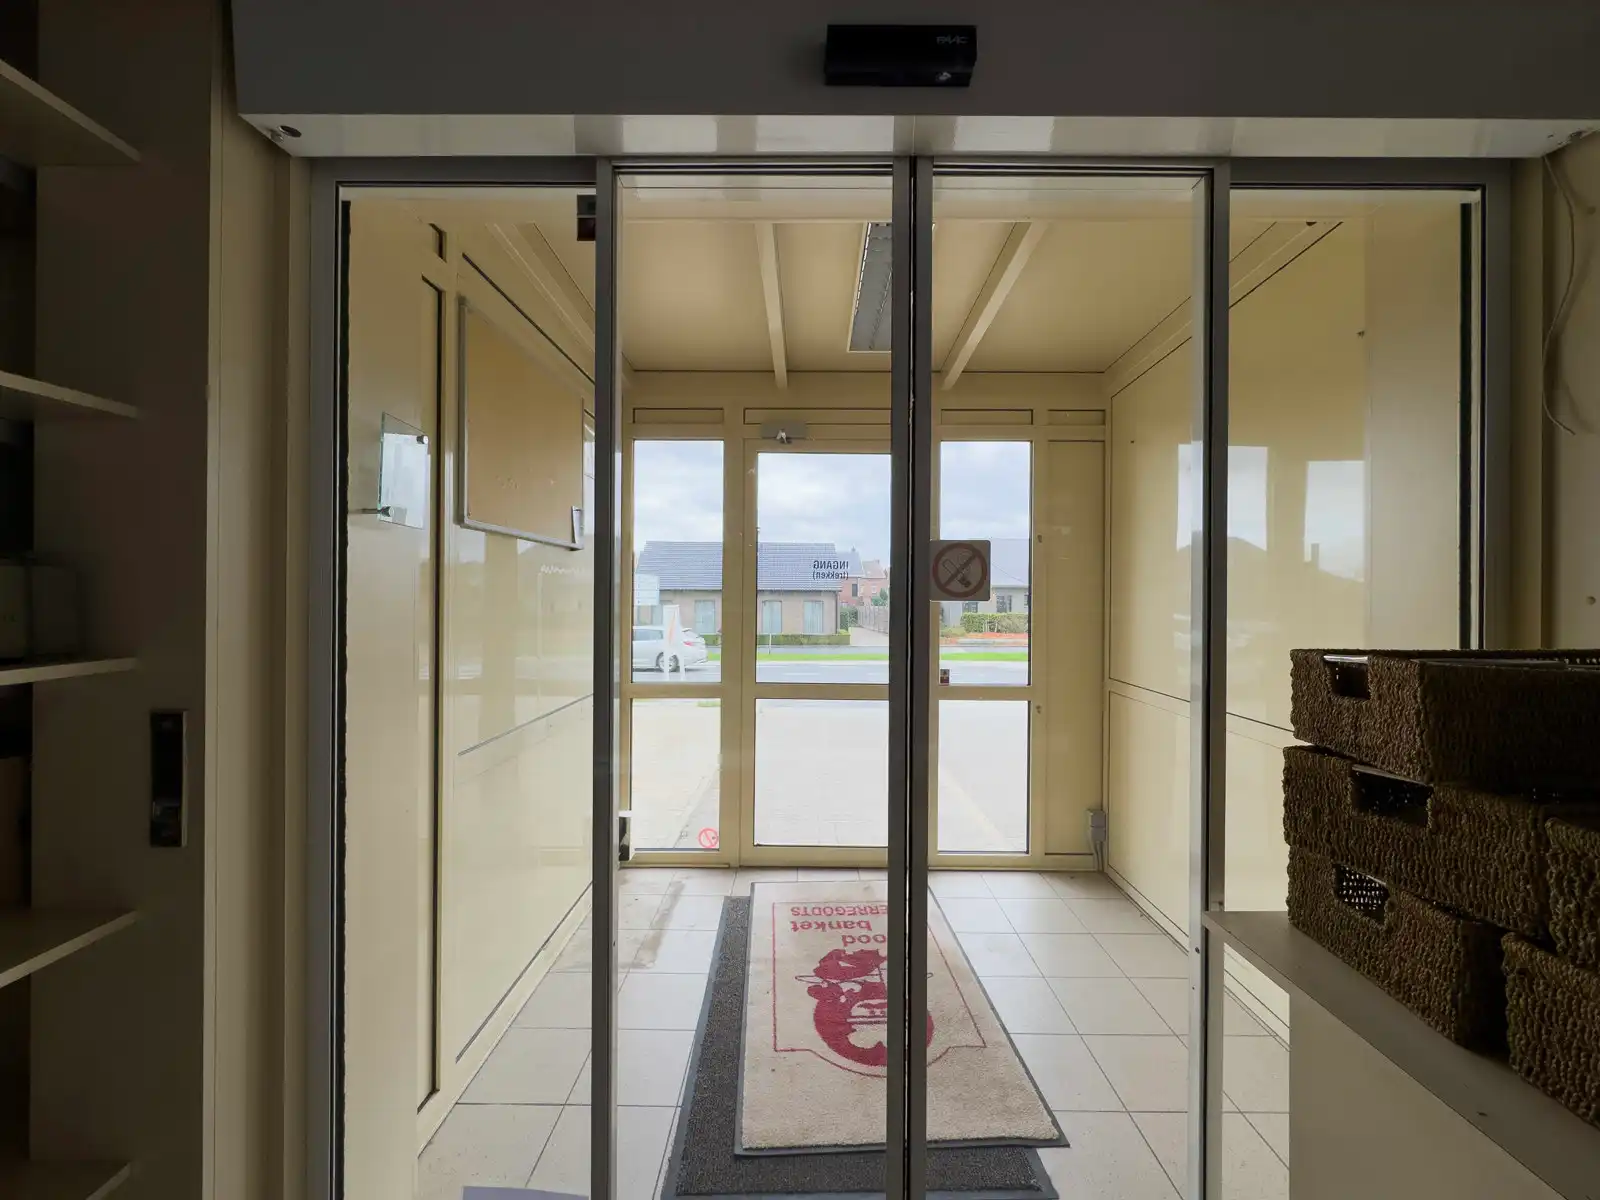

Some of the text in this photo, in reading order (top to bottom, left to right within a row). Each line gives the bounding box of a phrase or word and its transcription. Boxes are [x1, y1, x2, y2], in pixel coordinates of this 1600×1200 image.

[790, 905, 888, 916] ERREGODTS
[790, 920, 872, 932] banket
[841, 934, 887, 947] ood
